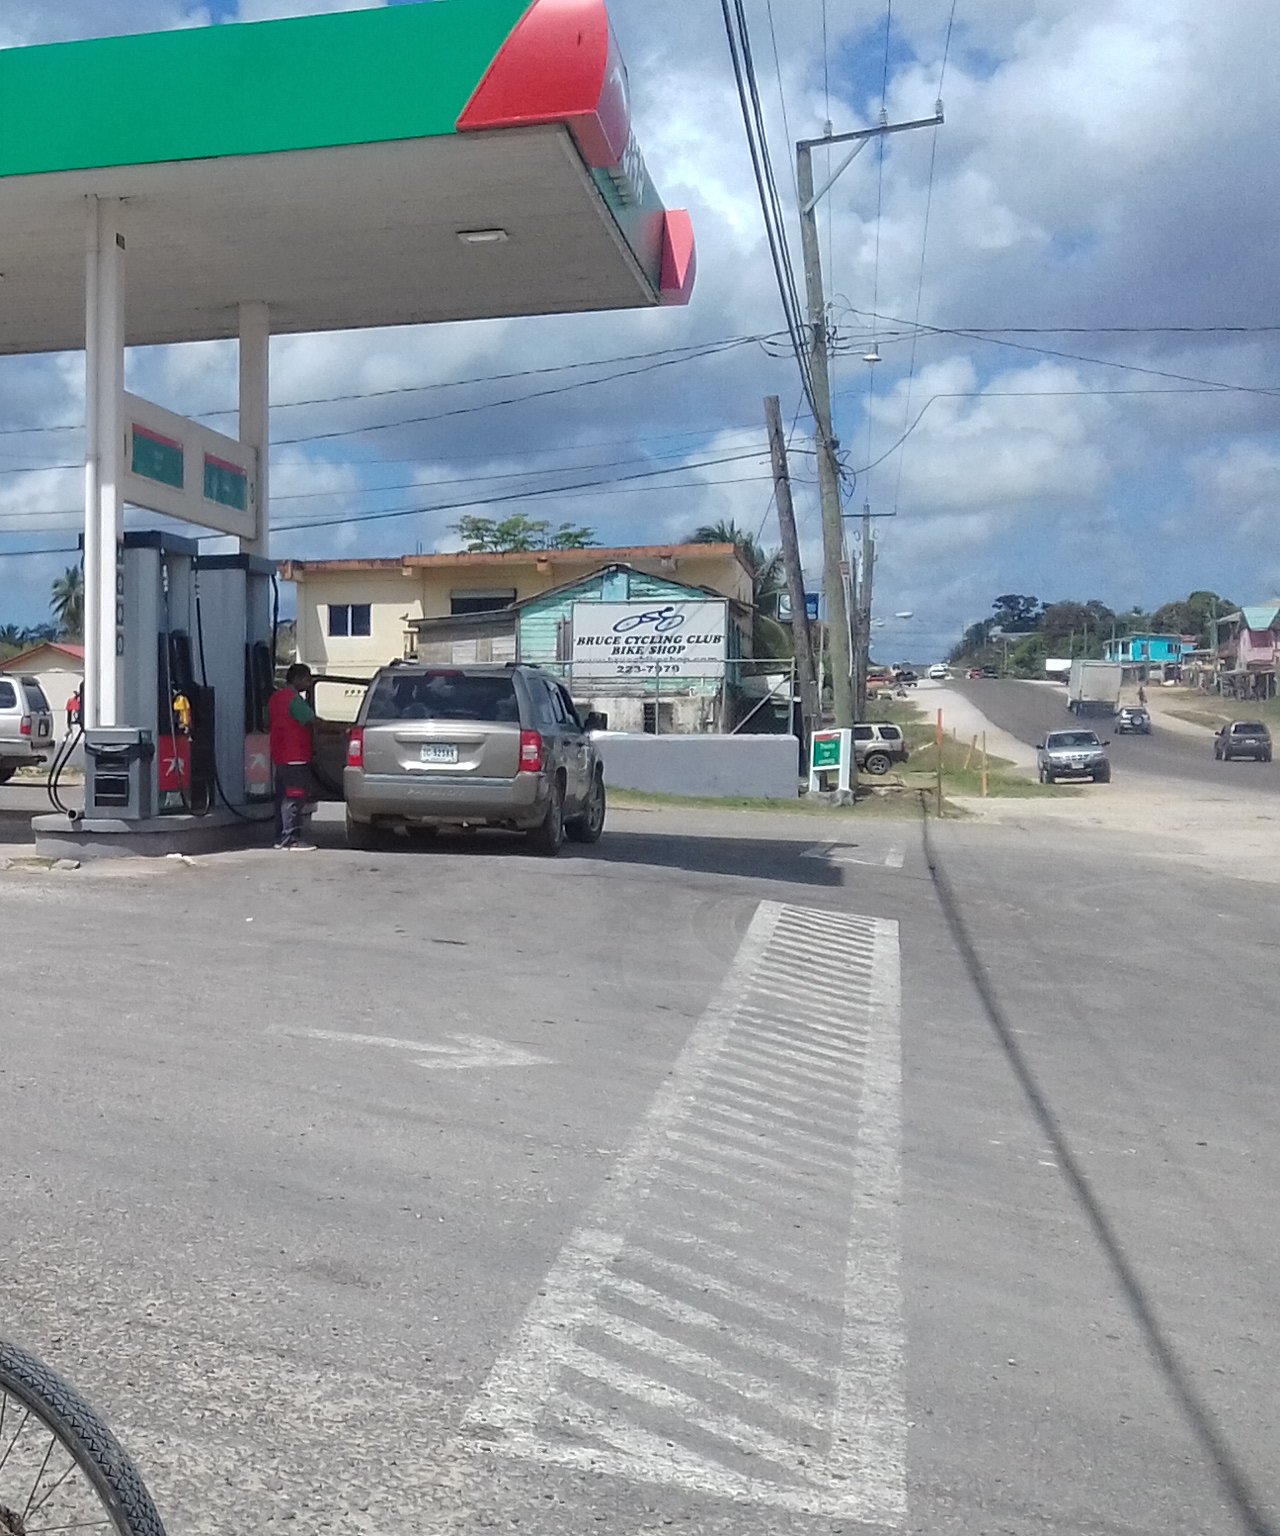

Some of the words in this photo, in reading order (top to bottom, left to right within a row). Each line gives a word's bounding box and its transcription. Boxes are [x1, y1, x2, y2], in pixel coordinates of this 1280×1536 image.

[576, 636, 620, 646] BRUCE
[624, 635, 682, 645] CYCLING
[686, 634, 721, 644] CLUB
[611, 645, 645, 655] BIKE
[648, 645, 686, 655] SHOP
